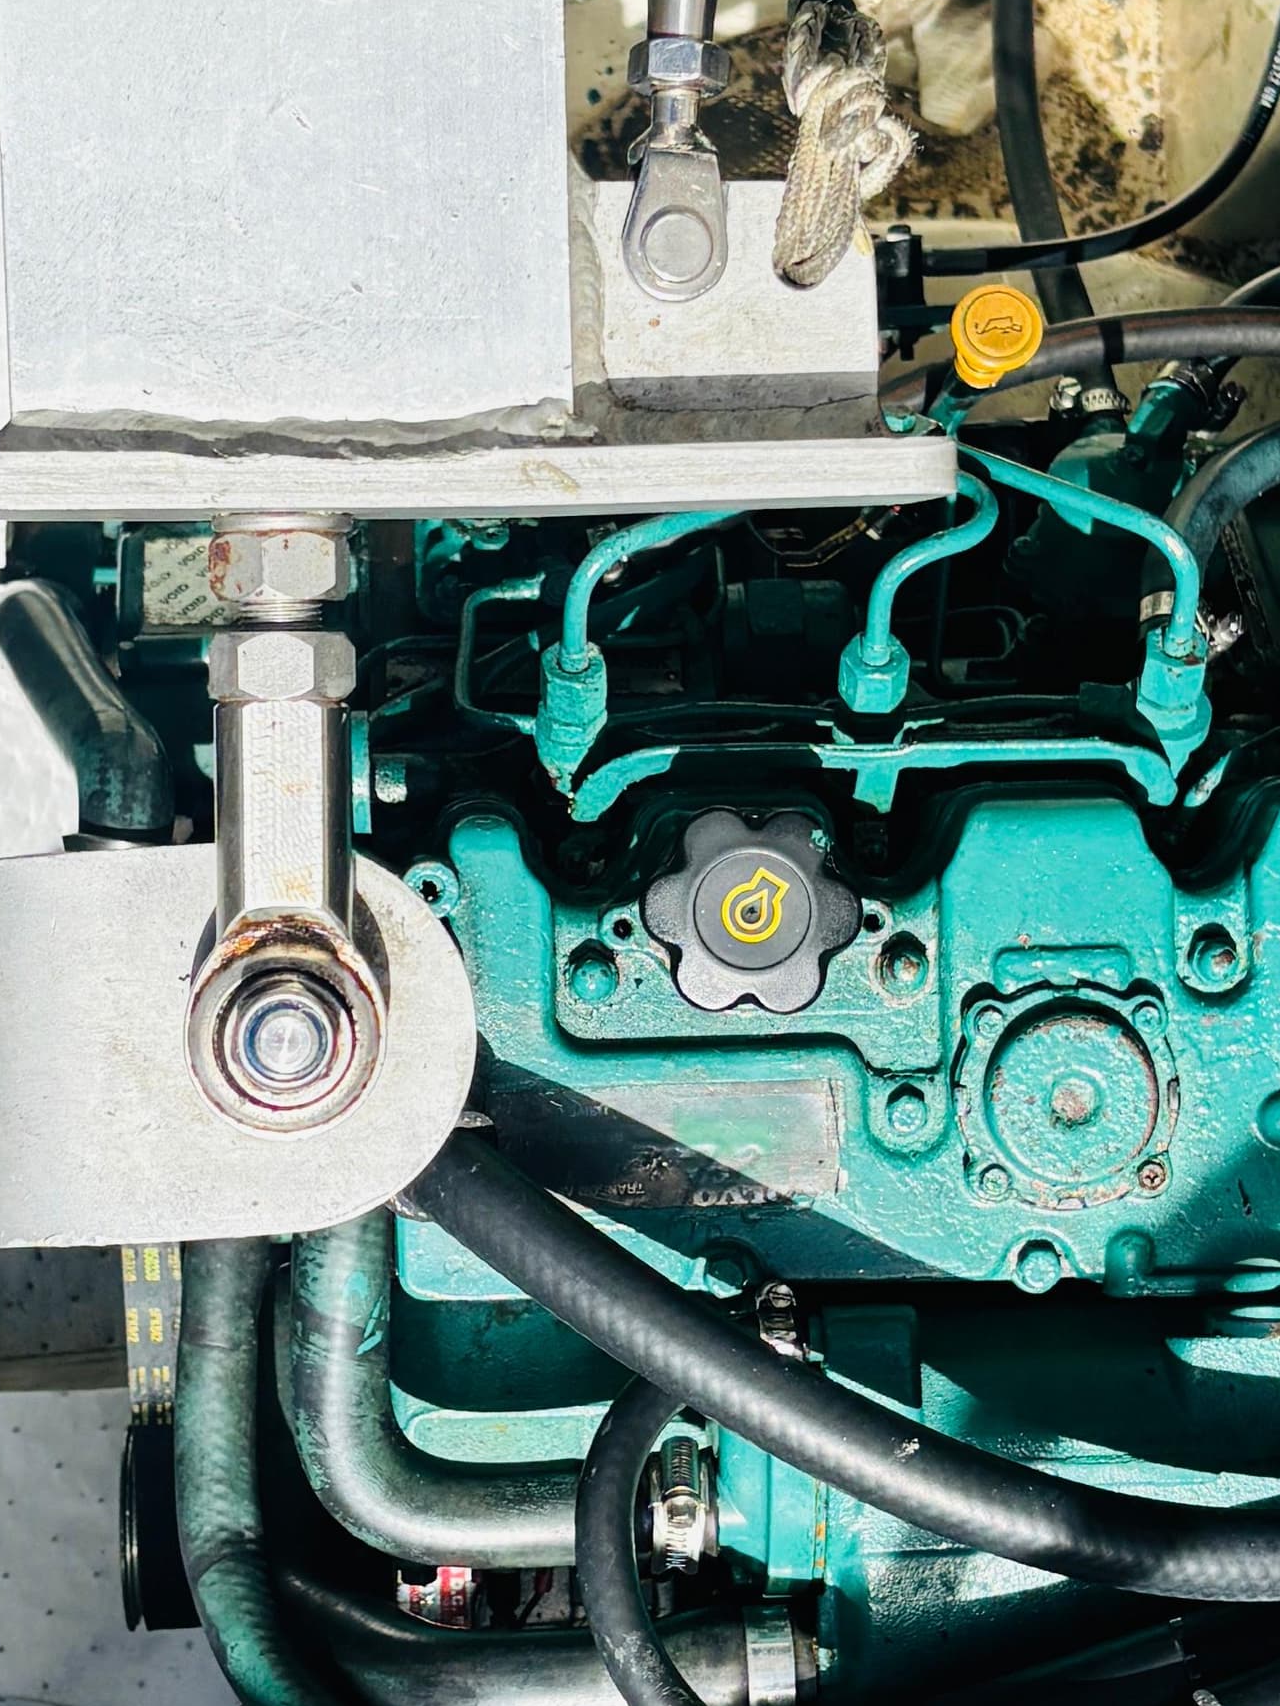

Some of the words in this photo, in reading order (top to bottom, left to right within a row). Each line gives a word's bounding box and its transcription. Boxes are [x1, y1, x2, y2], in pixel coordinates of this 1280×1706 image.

[178, 544, 207, 567] VOID
[159, 583, 190, 605] VOID
[177, 594, 208, 616] VOID
